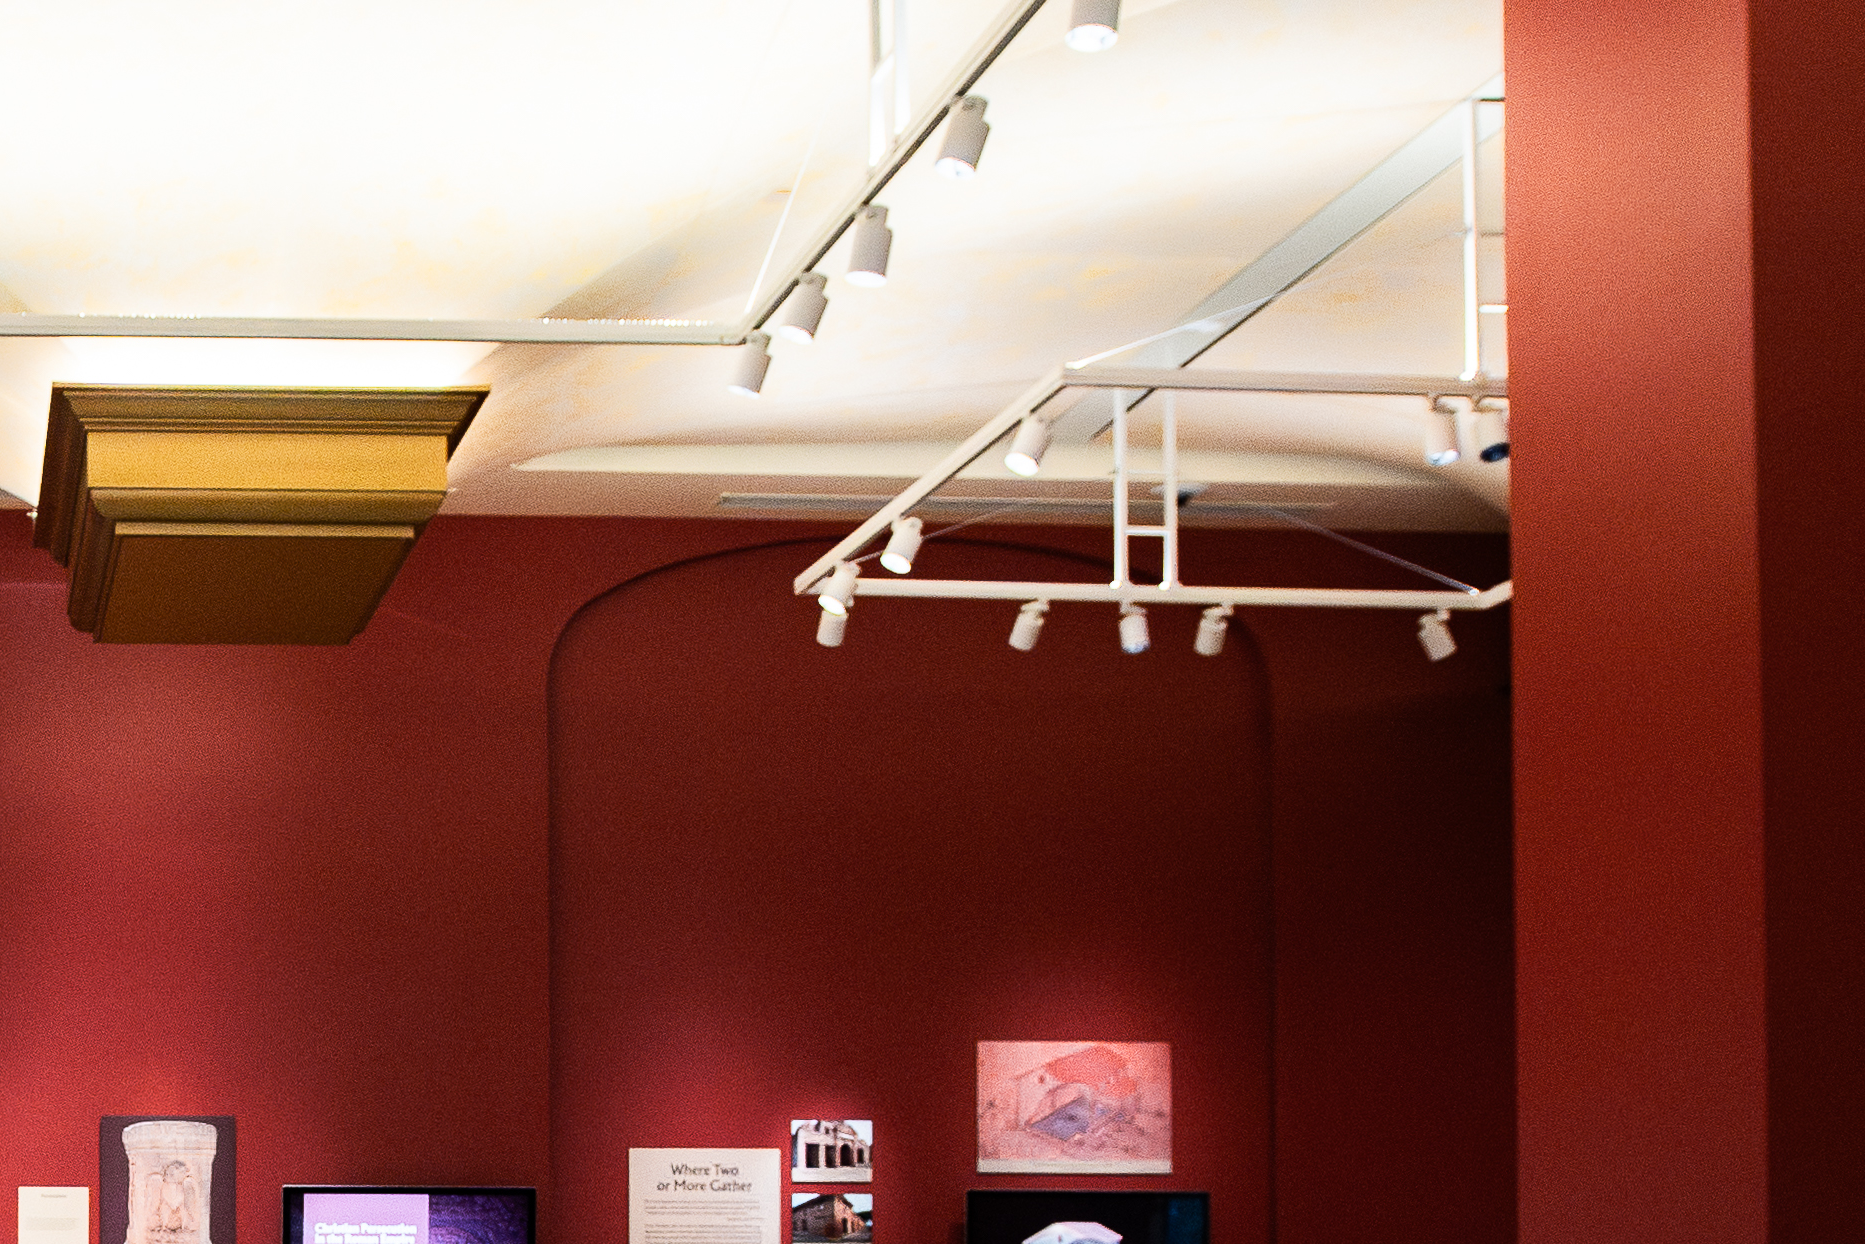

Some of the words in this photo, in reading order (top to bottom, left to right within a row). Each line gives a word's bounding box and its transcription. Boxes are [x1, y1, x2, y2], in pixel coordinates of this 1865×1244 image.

[671, 1162, 710, 1176] Where
[712, 1163, 739, 1176] Two
[656, 1182, 670, 1191] or
[674, 1180, 706, 1191] More
